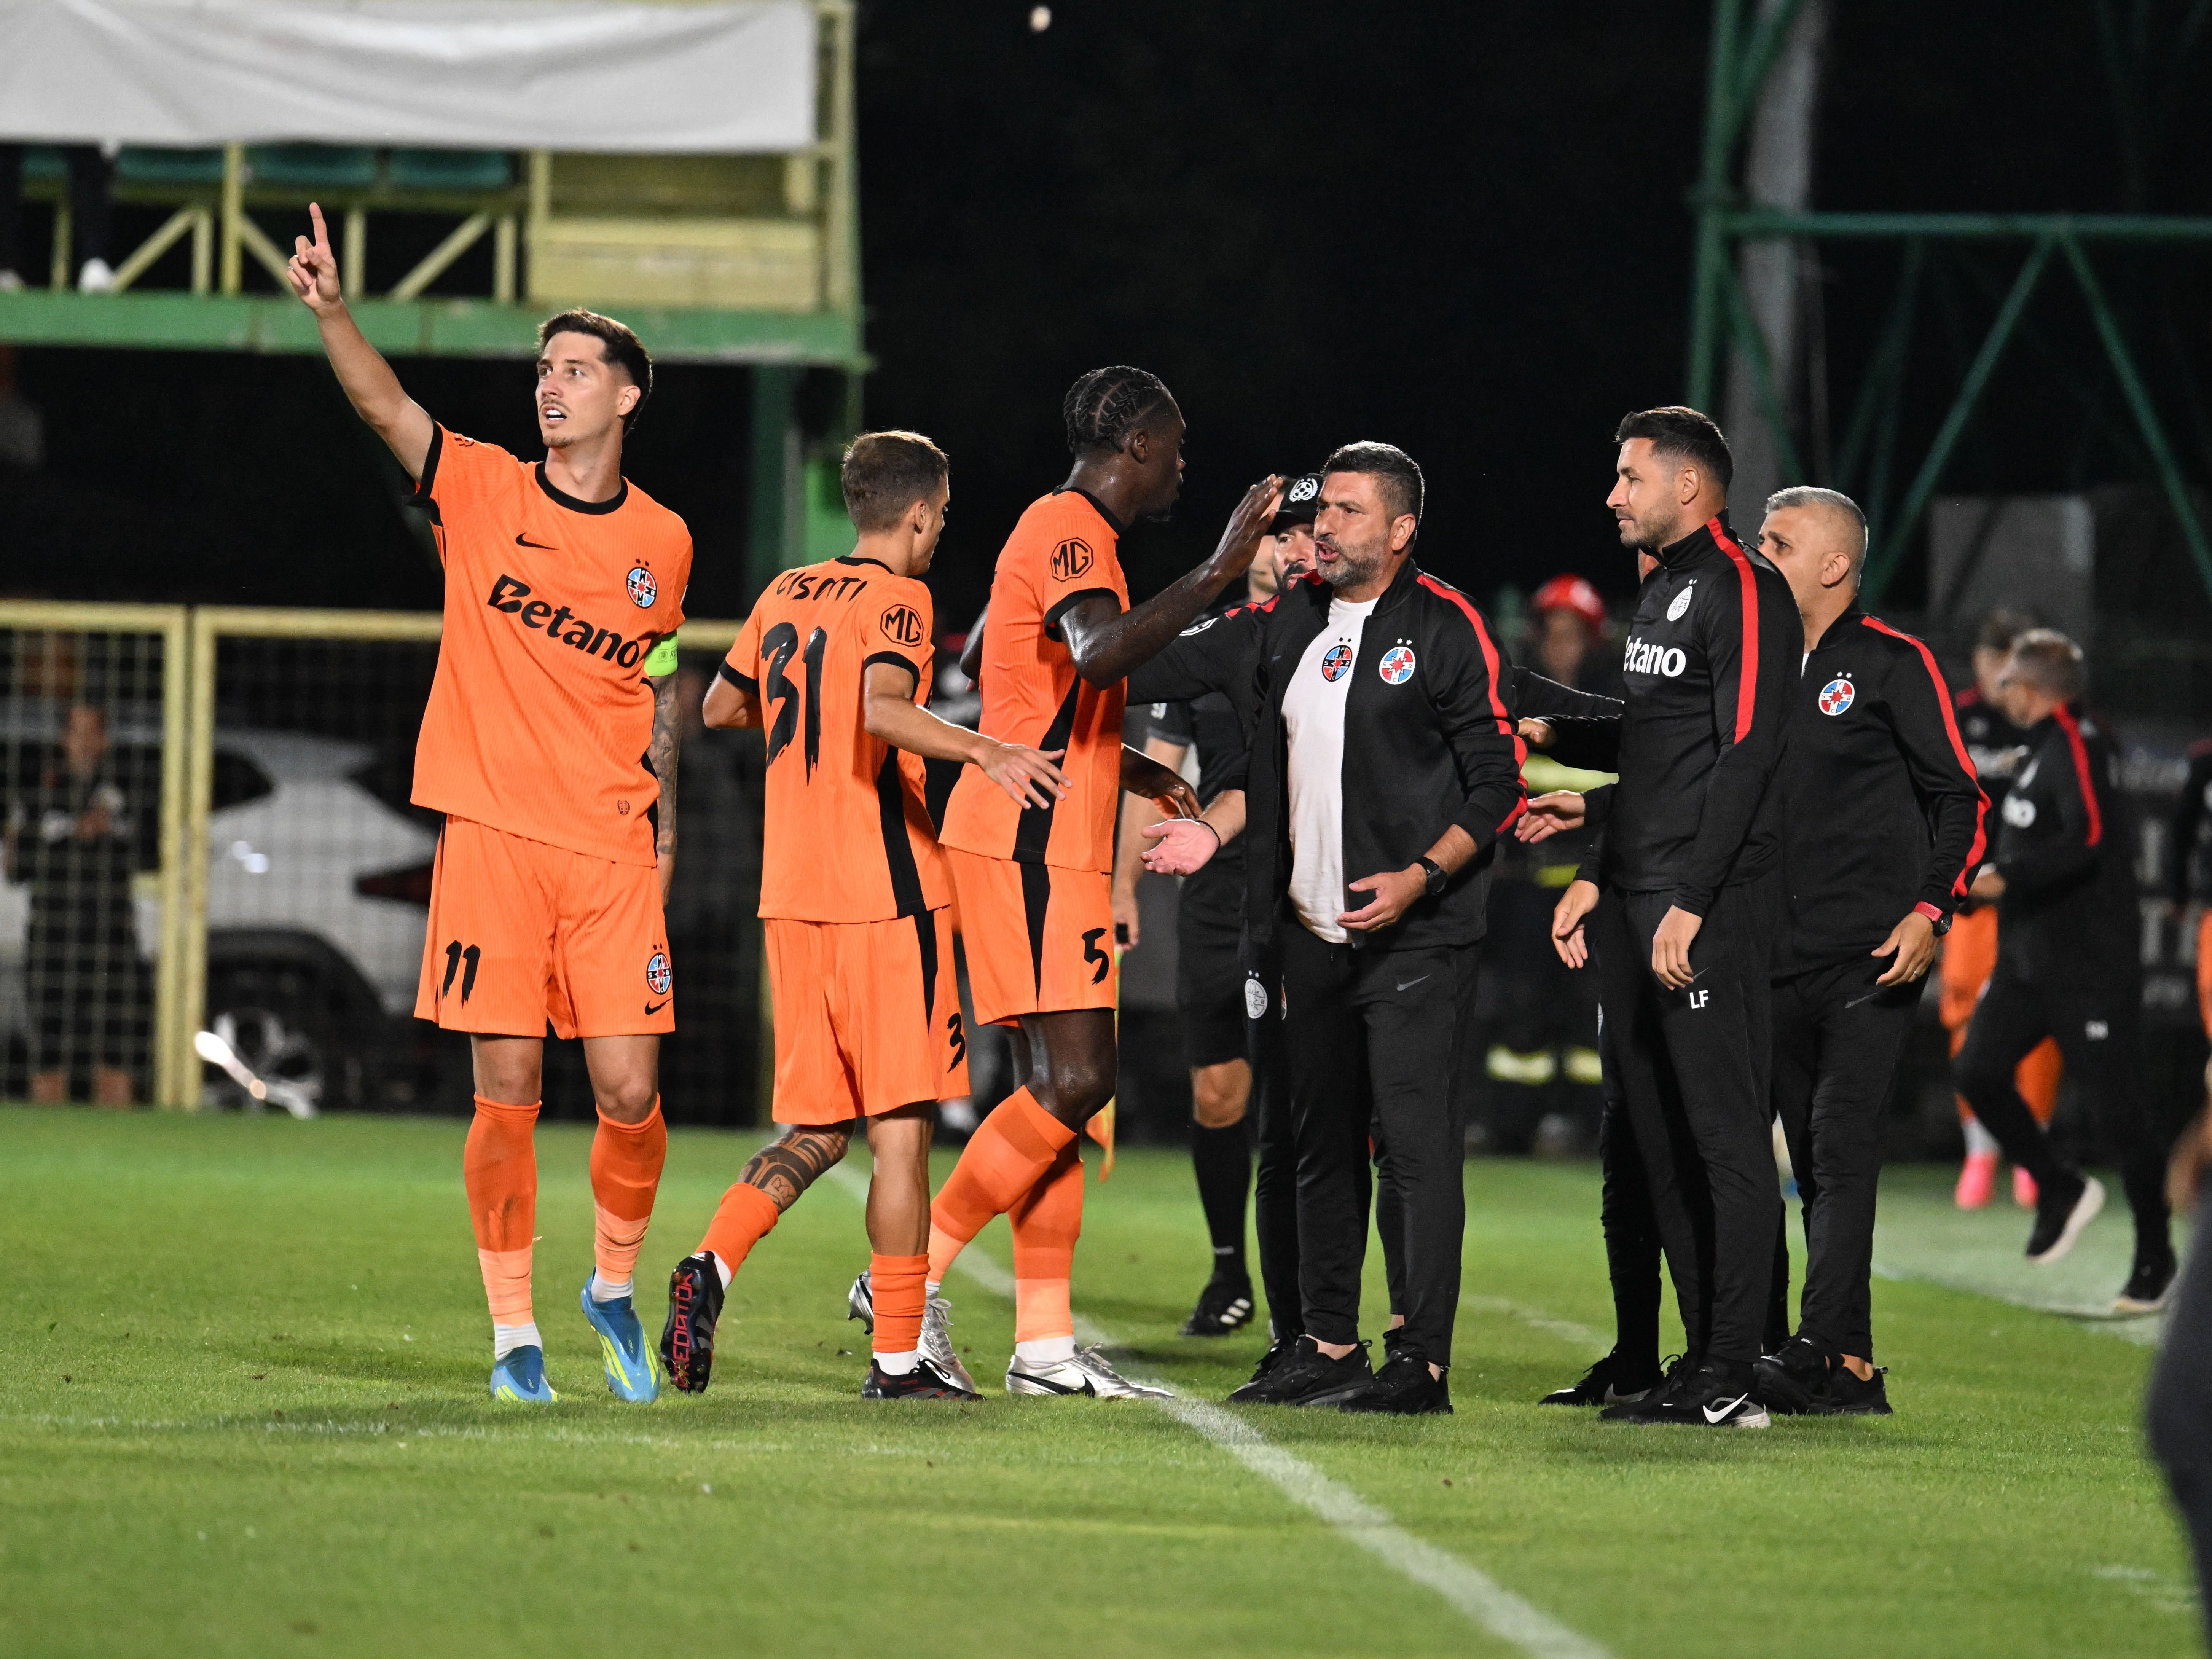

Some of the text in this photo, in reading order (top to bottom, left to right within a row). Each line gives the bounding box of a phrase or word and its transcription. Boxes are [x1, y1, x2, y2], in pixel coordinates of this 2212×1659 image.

[1053, 541, 1089, 577] MG
[487, 574, 640, 668] Betano
[885, 607, 921, 643] MG
[1624, 635, 1686, 677] etano
[761, 622, 827, 787] 31
[442, 940, 481, 1009] 11
[1081, 928, 1109, 985] 5
[1690, 990, 1709, 1009] LF
